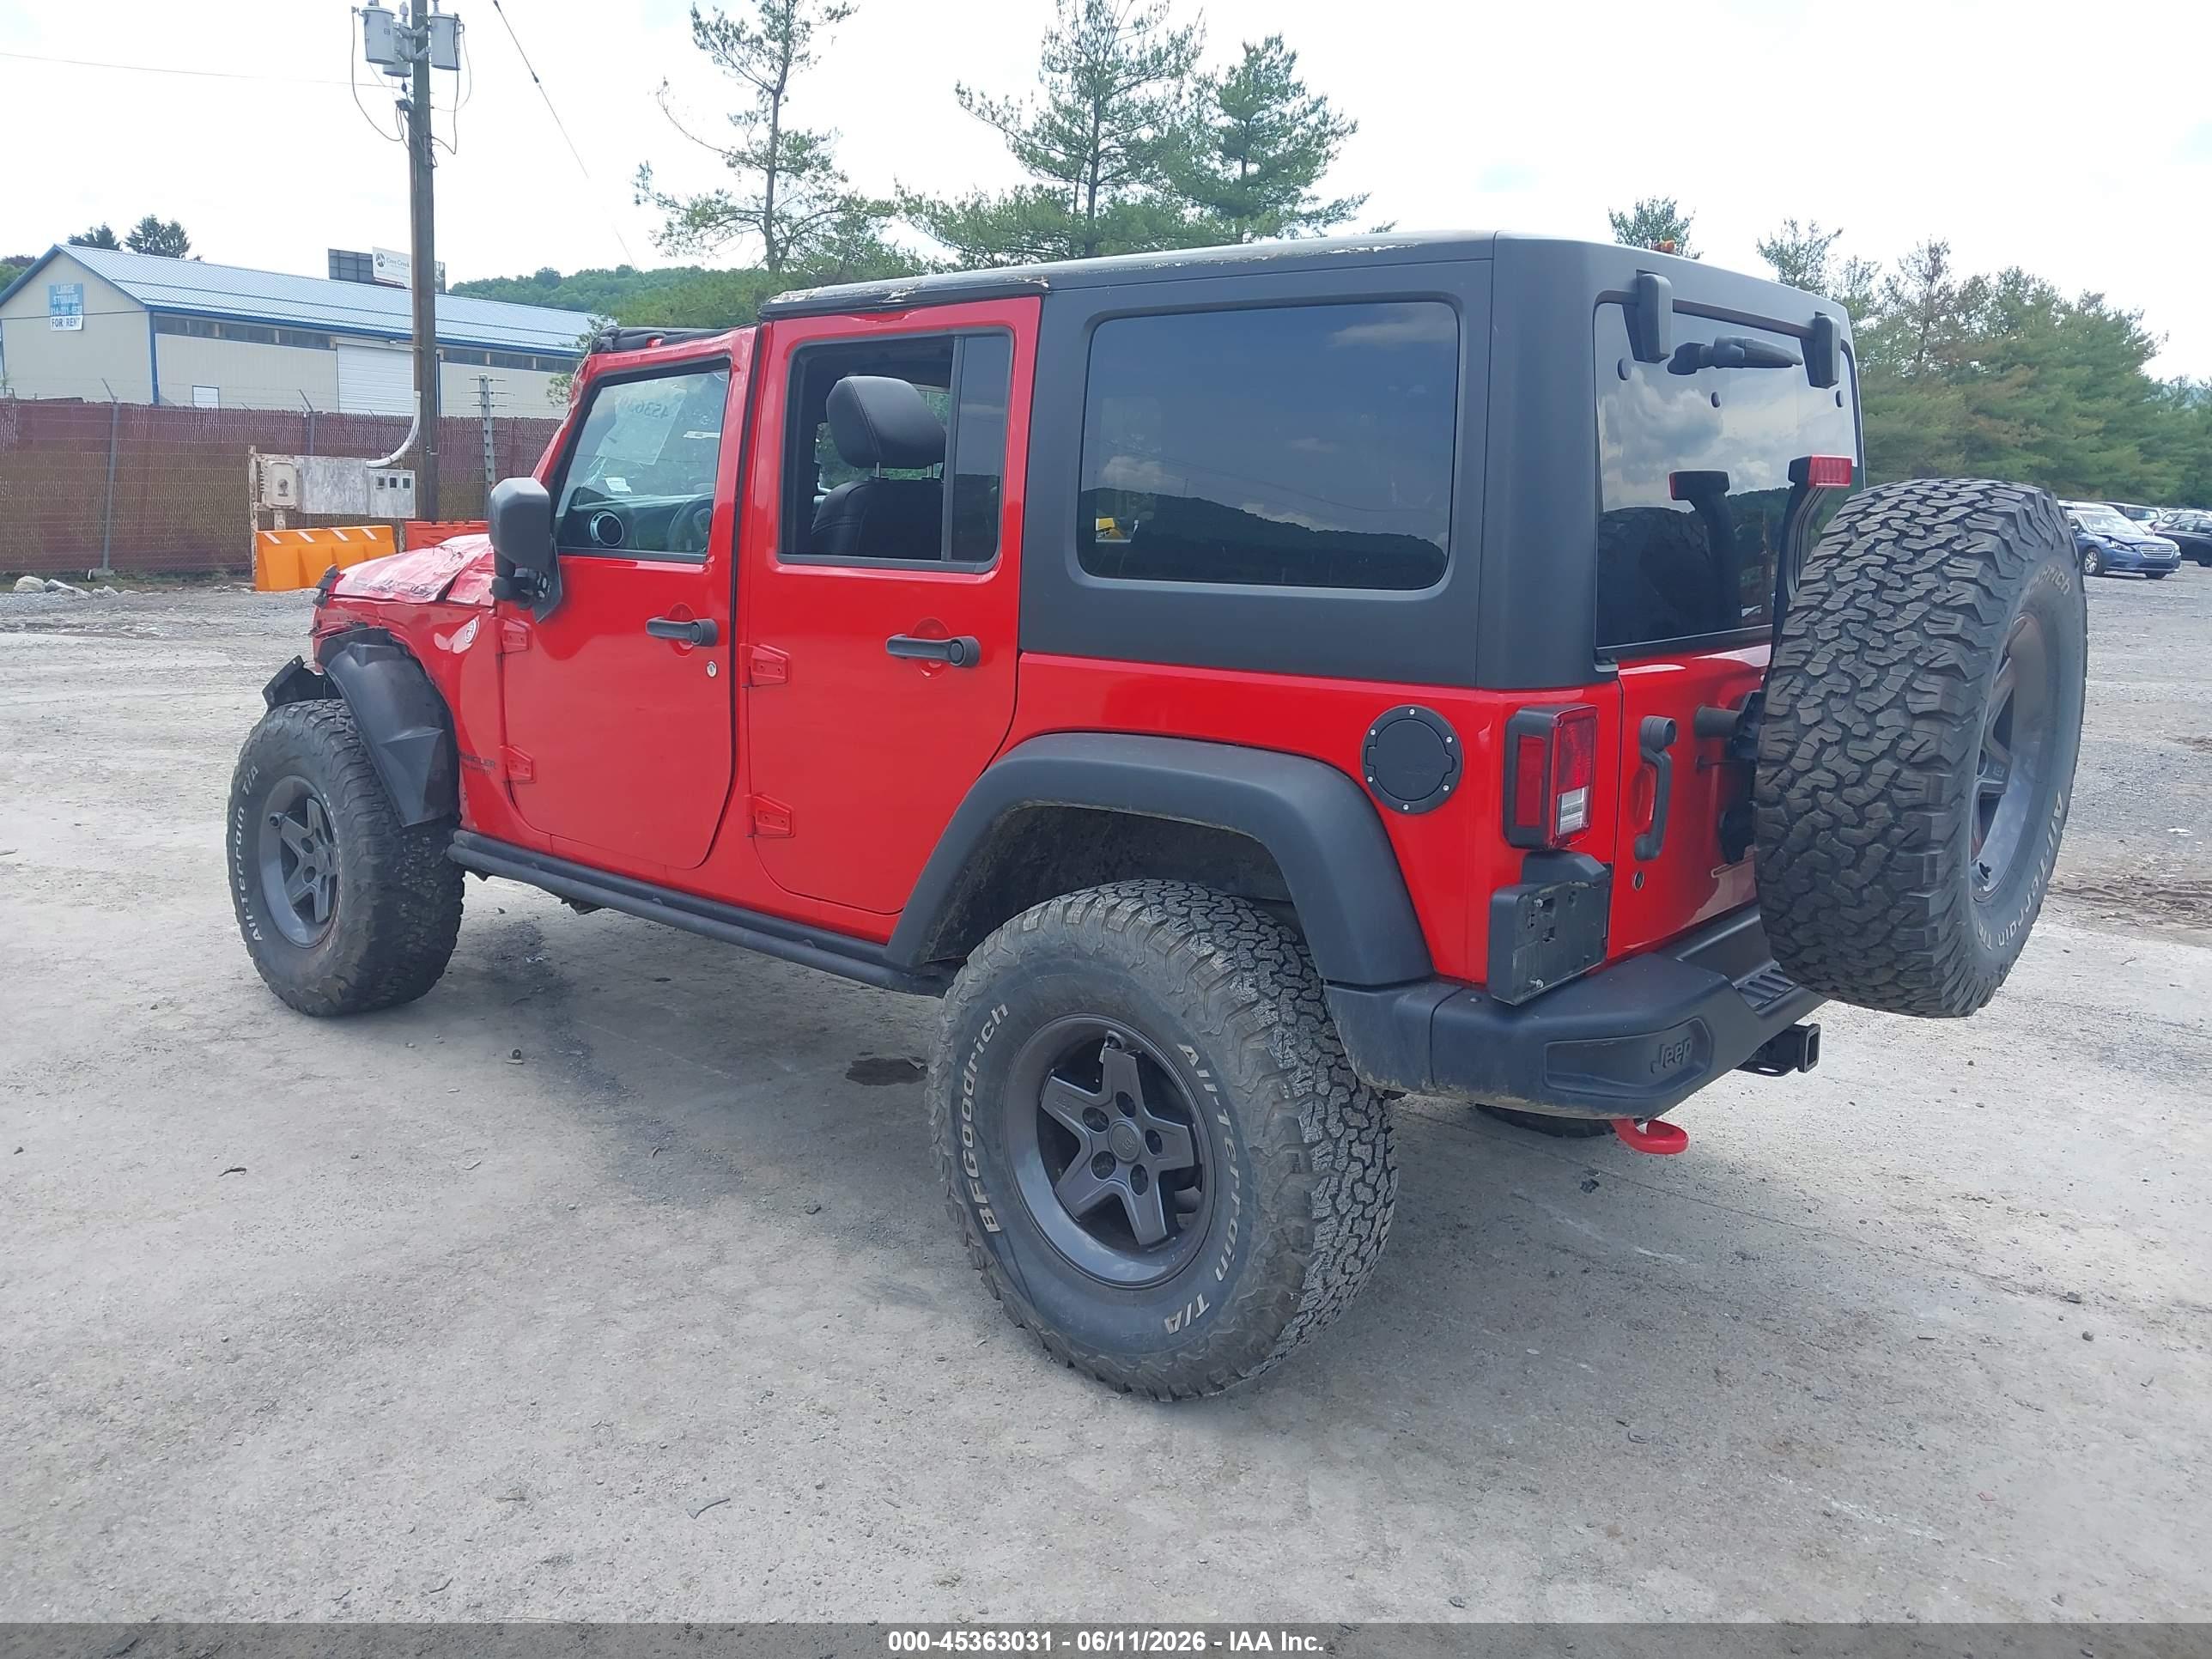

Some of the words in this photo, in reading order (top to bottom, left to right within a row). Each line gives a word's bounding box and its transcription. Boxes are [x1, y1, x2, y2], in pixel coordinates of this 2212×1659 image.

[52, 318, 64, 328] FOR
[65, 317, 82, 327] RENT
[1650, 1036, 1691, 1074] Jeep
[962, 1003, 1009, 1233] BFGoodrich
[1177, 1042, 1242, 1281] All-Terrain
[1164, 1293, 1211, 1334] T/A
